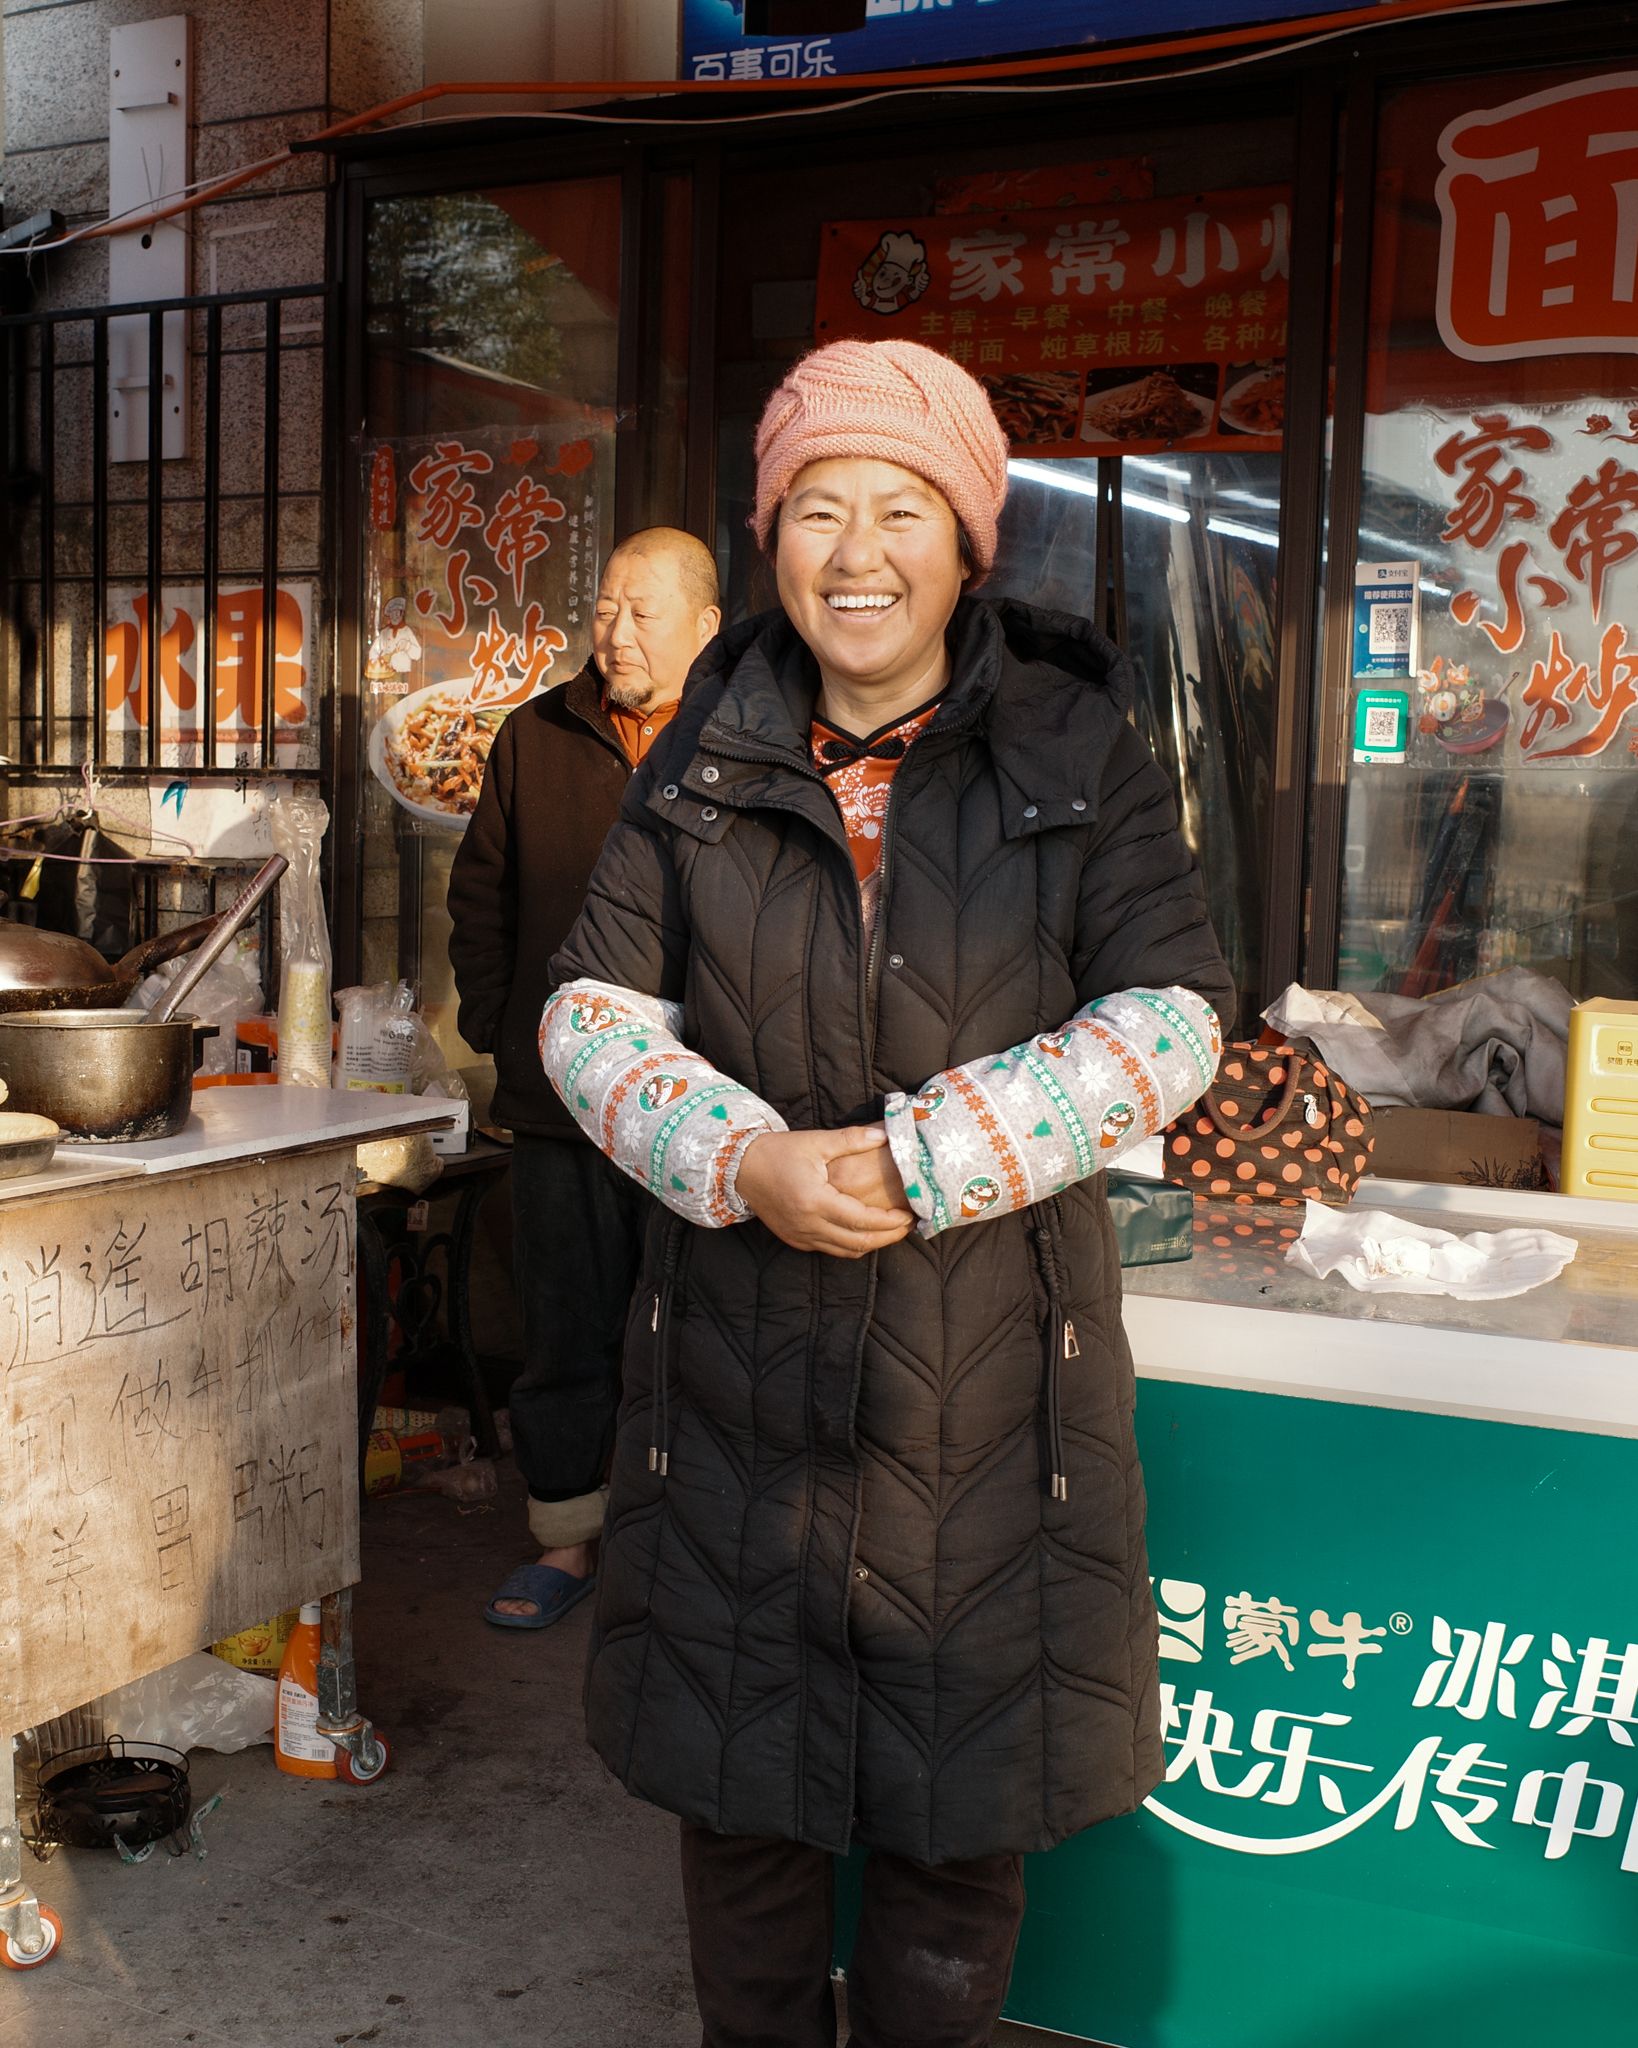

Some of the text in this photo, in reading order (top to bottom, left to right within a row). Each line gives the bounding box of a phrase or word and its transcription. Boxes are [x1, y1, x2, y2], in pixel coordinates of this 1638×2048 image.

[692, 38, 836, 81] 百事可乐
[1434, 70, 1638, 362] 面
[106, 587, 308, 728] 水果
[1160, 1683, 1638, 1873] 快乐传中
